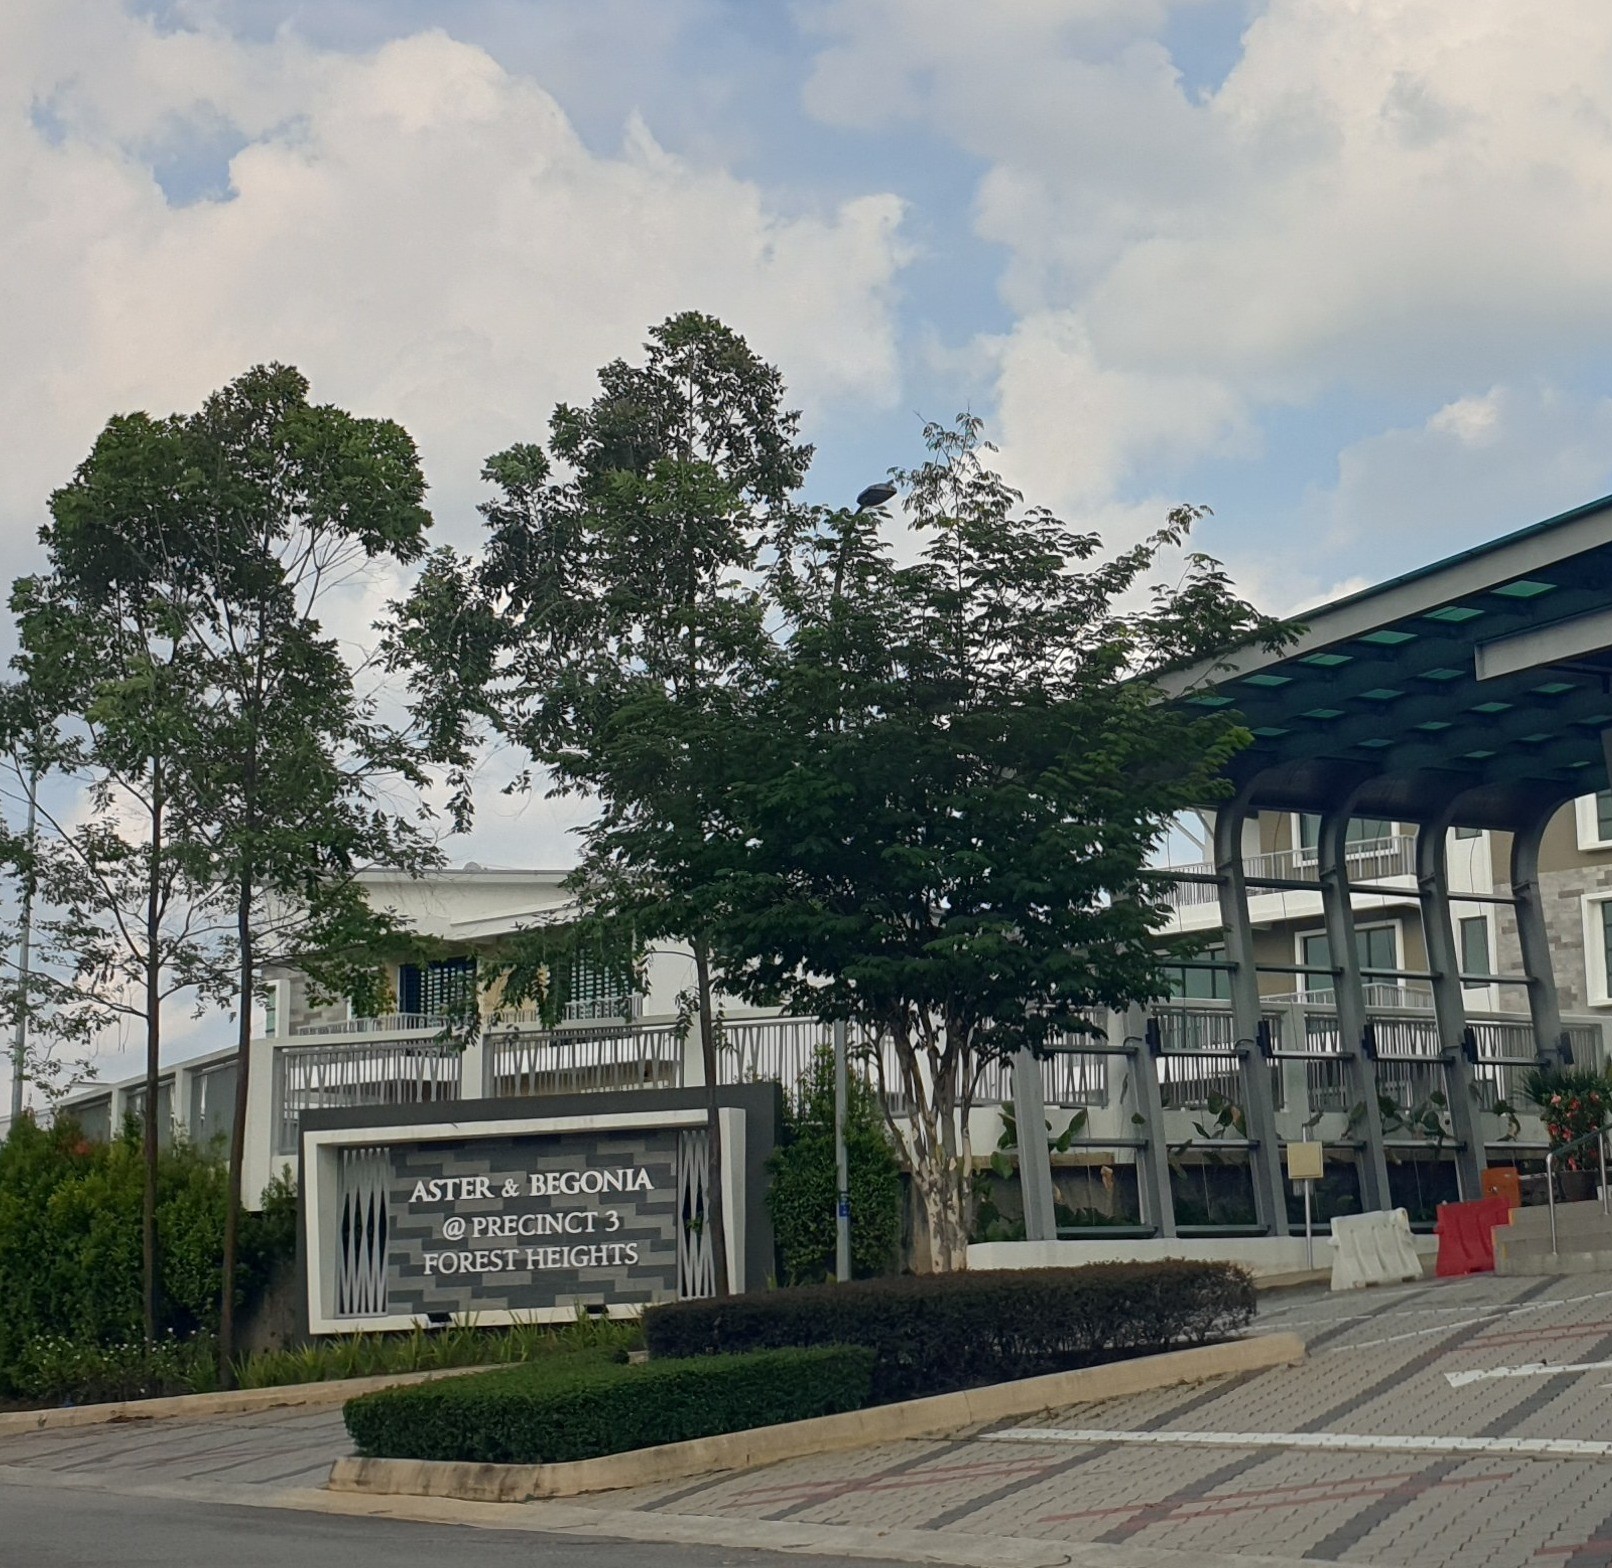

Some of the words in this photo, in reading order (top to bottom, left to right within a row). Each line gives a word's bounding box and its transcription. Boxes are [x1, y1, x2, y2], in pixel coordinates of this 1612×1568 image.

[408, 1176, 495, 1202] ASTER
[501, 1178, 520, 1198] &
[529, 1168, 654, 1196] BEGONIA
[442, 1216, 466, 1241] @
[471, 1211, 598, 1237] PRECINCT
[604, 1210, 620, 1232] 3
[423, 1248, 520, 1275] FOREST
[524, 1242, 639, 1270] HEIGHTS
